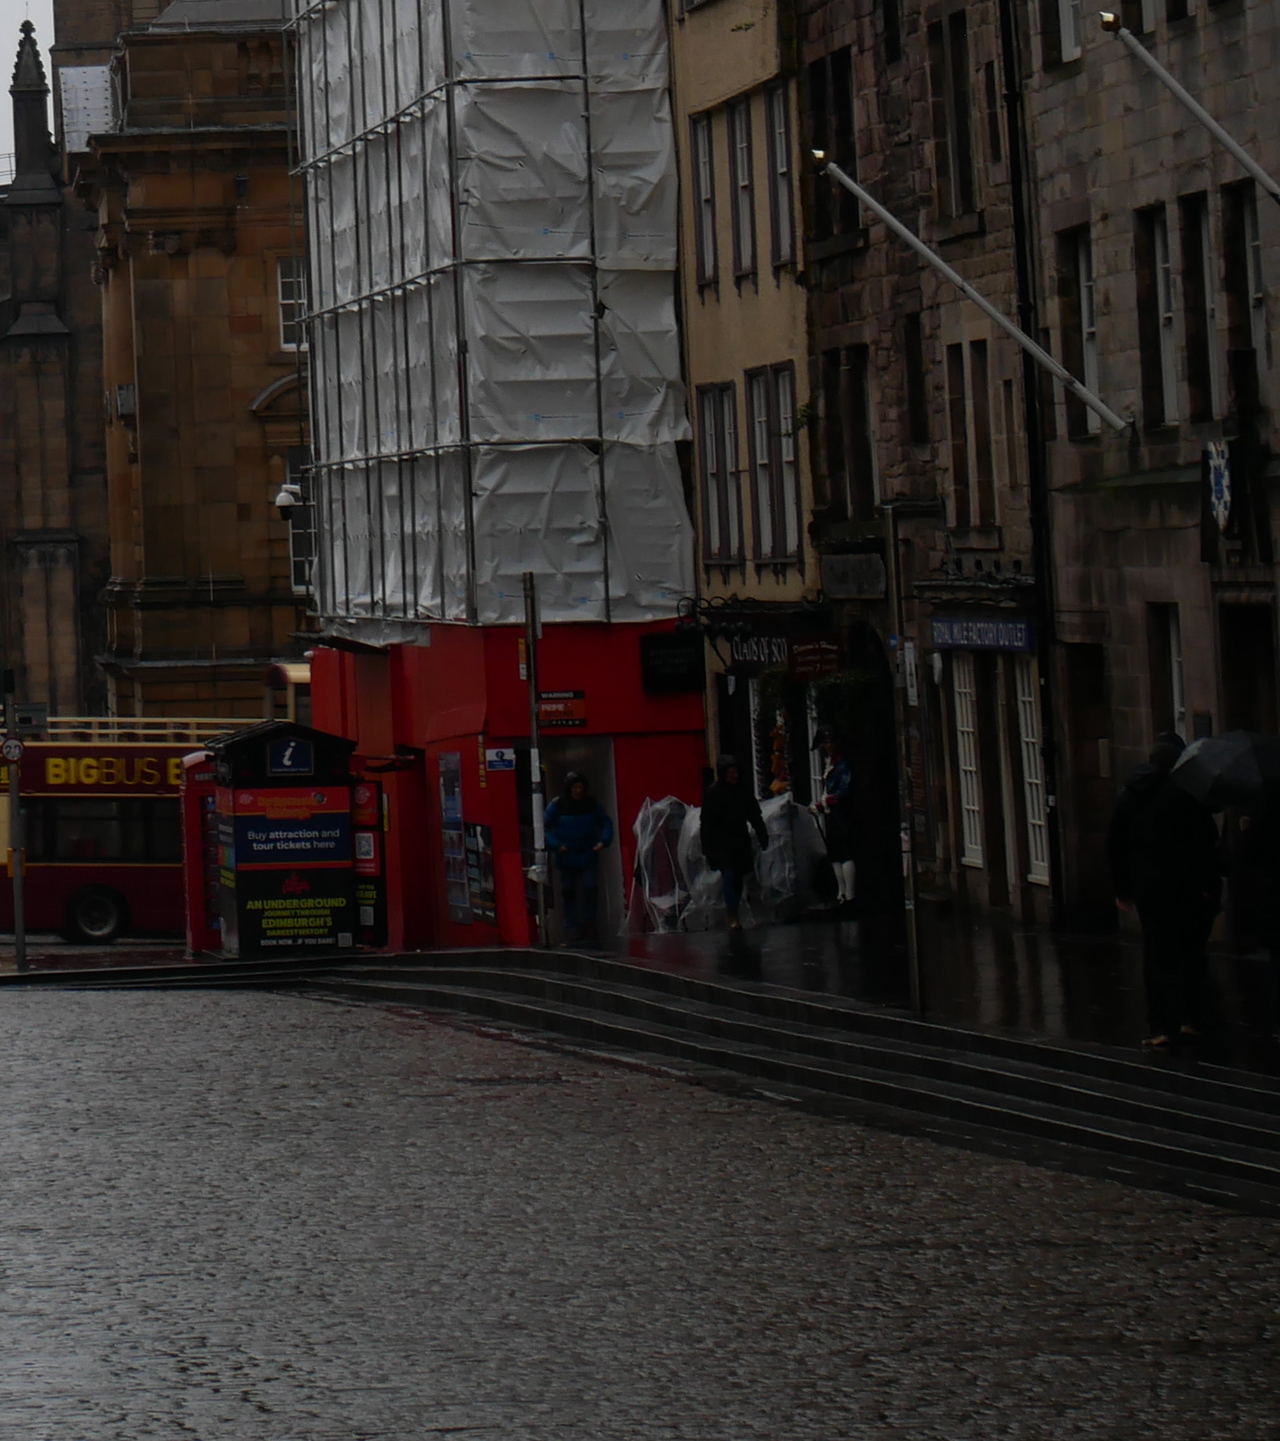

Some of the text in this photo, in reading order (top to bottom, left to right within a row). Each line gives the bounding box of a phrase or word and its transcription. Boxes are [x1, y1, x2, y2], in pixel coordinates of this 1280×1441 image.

[247, 828, 340, 842] Buy attraction and
[252, 839, 336, 851] tour tickets here
[246, 900, 263, 910] AN
[263, 898, 347, 909] UNDERGROUND
